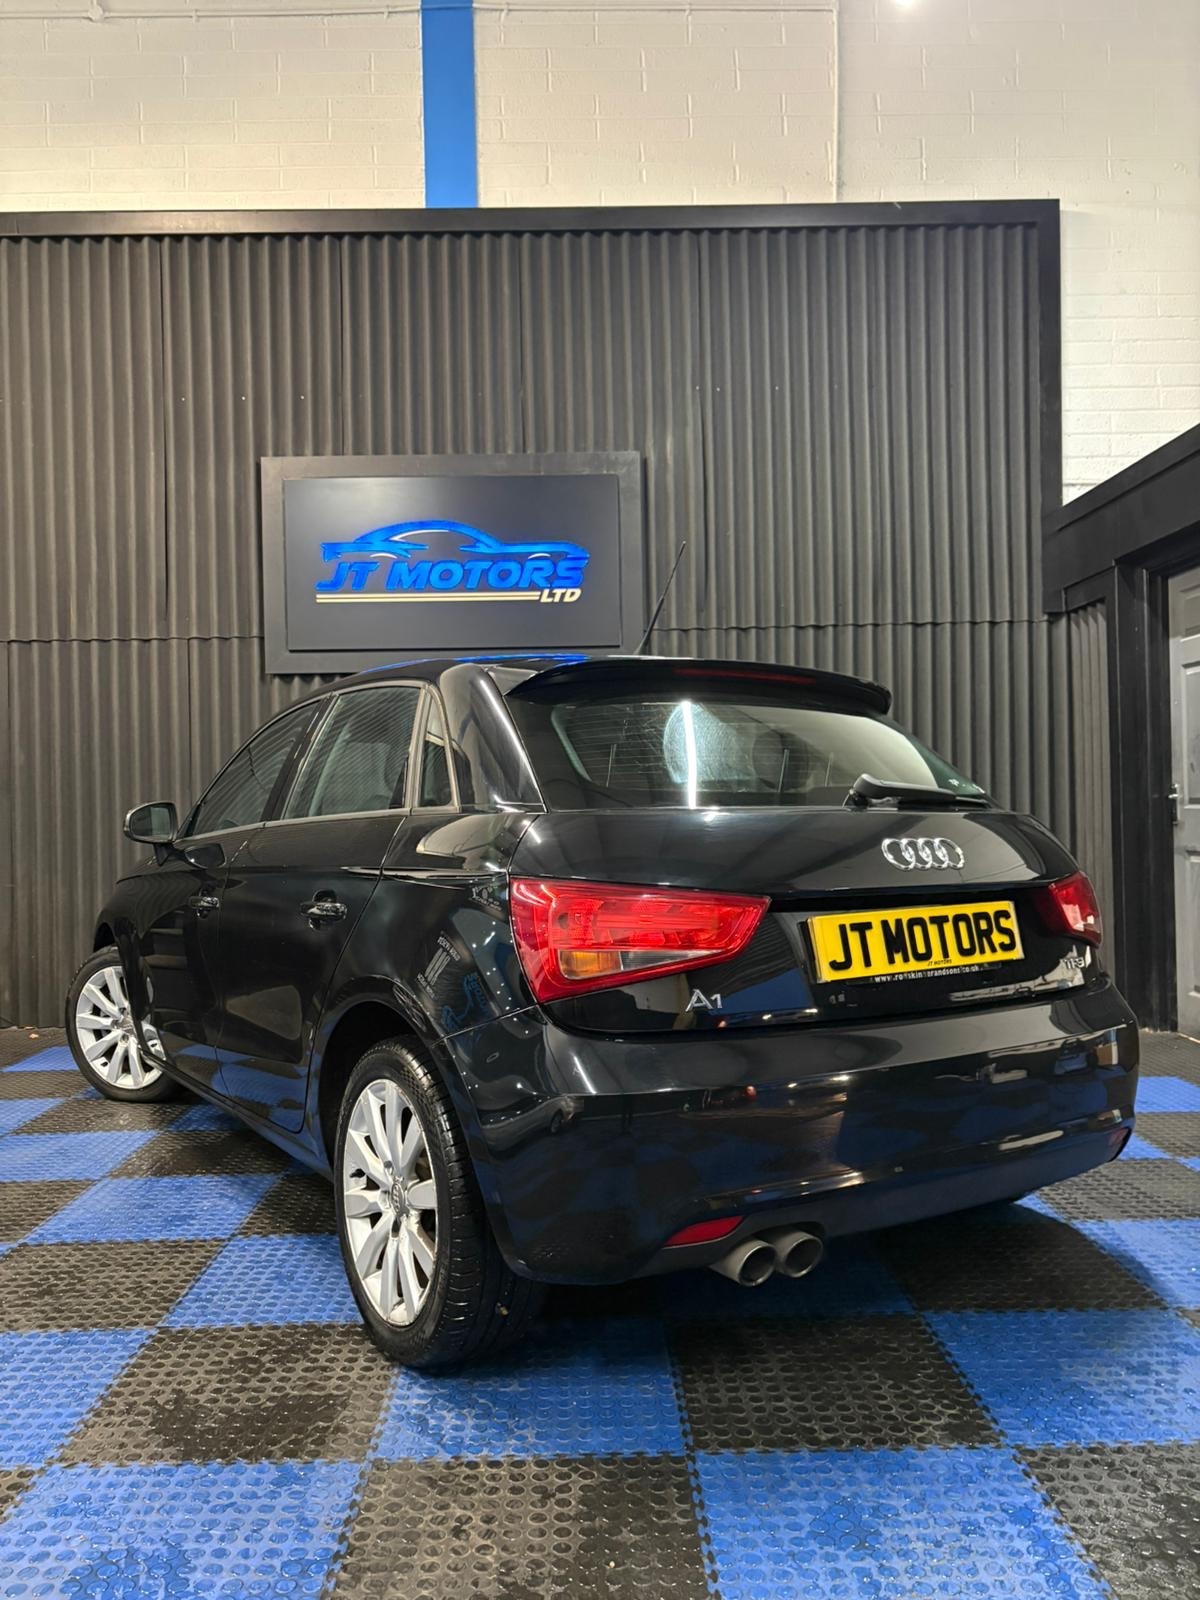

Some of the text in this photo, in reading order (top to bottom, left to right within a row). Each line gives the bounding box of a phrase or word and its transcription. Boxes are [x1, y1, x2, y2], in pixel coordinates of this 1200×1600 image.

[315, 559, 588, 592] JT MOTORS
[540, 588, 582, 603] LTD
[829, 909, 1017, 972] JT MOTORS
[934, 958, 952, 966] MOTORS
[685, 988, 723, 1012] A1
